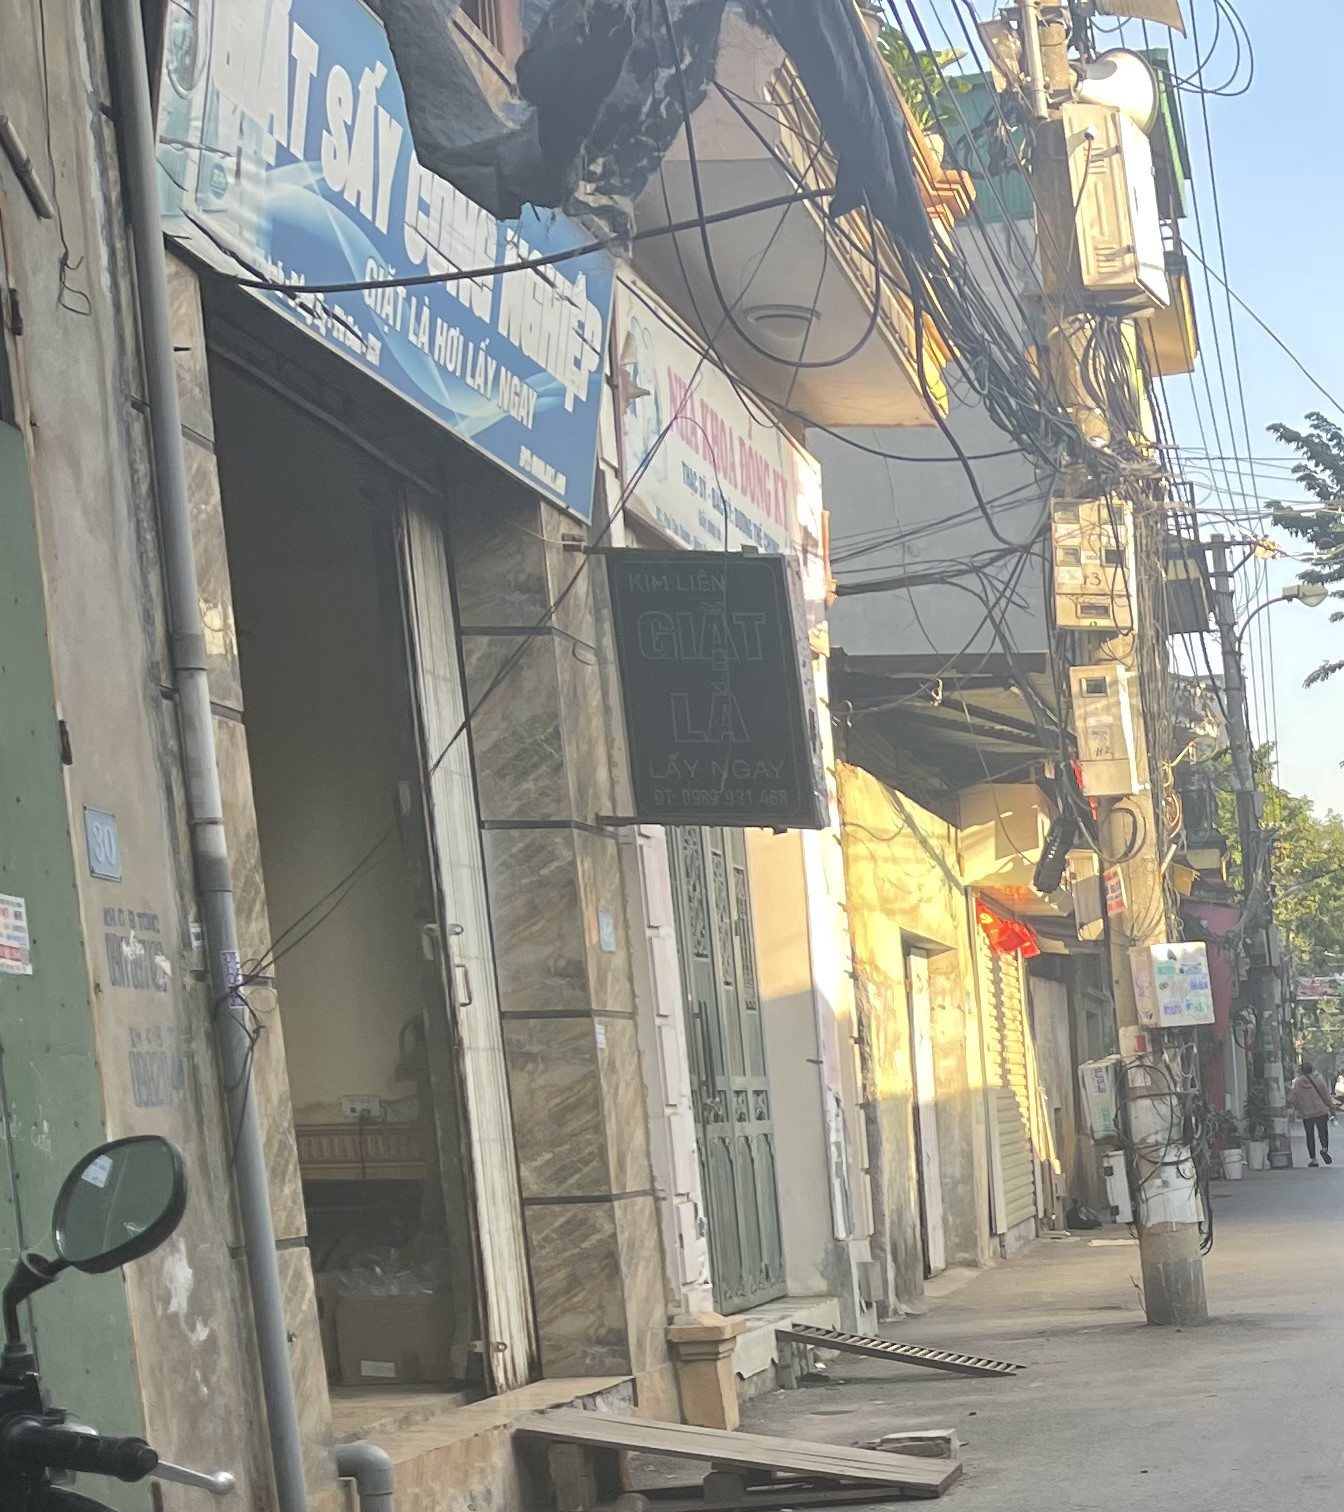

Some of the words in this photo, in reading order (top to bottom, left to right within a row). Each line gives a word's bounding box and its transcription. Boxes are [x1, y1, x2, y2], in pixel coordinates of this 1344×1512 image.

[321, 59, 404, 236] SẤY
[498, 226, 603, 413] NGHIỆP
[363, 257, 407, 334] GIẶT
[408, 295, 430, 359] LÀ
[433, 317, 465, 378] HƠI
[465, 337, 497, 402] LẤY
[498, 364, 538, 431] NGAY
[667, 365, 699, 455] NHA
[700, 397, 739, 490] KHOA
[629, 573, 669, 592] KIM
[677, 569, 726, 592] LIÊN
[637, 601, 766, 671] GIẶT
[670, 681, 750, 743] LÀ
[650, 752, 700, 779] LẤY
[711, 759, 785, 780] NGAY
